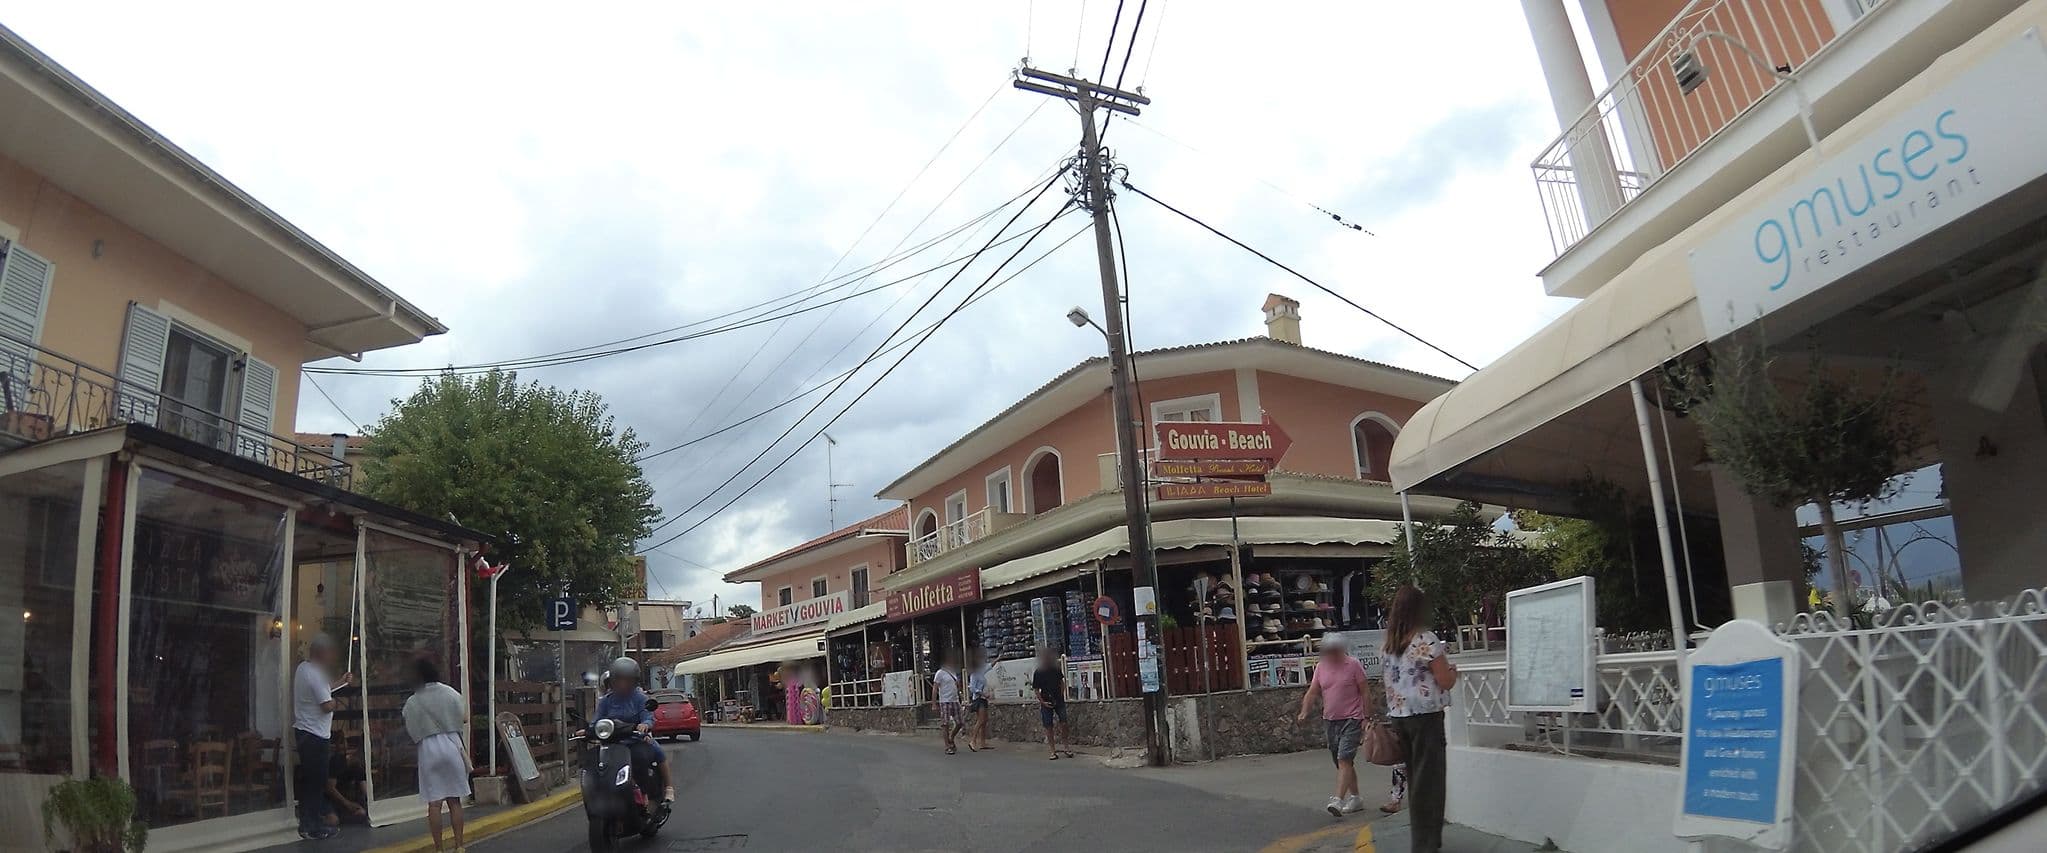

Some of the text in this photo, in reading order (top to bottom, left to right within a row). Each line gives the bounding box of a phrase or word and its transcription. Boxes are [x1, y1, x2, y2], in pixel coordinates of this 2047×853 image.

[1755, 109, 1968, 291] gmuses
[1803, 166, 1981, 272] restaurant
[1168, 429, 1272, 450] Gouvia Beach
[1163, 465, 1202, 474] Molfetta
[1214, 486, 1240, 495] Beach
[1244, 484, 1267, 494] Hotel
[902, 582, 954, 615] Molfetta
[555, 601, 569, 627] P
[753, 609, 789, 631] MARKET
[800, 597, 843, 621] GOUVIA
[1704, 674, 1762, 698] gmuses
